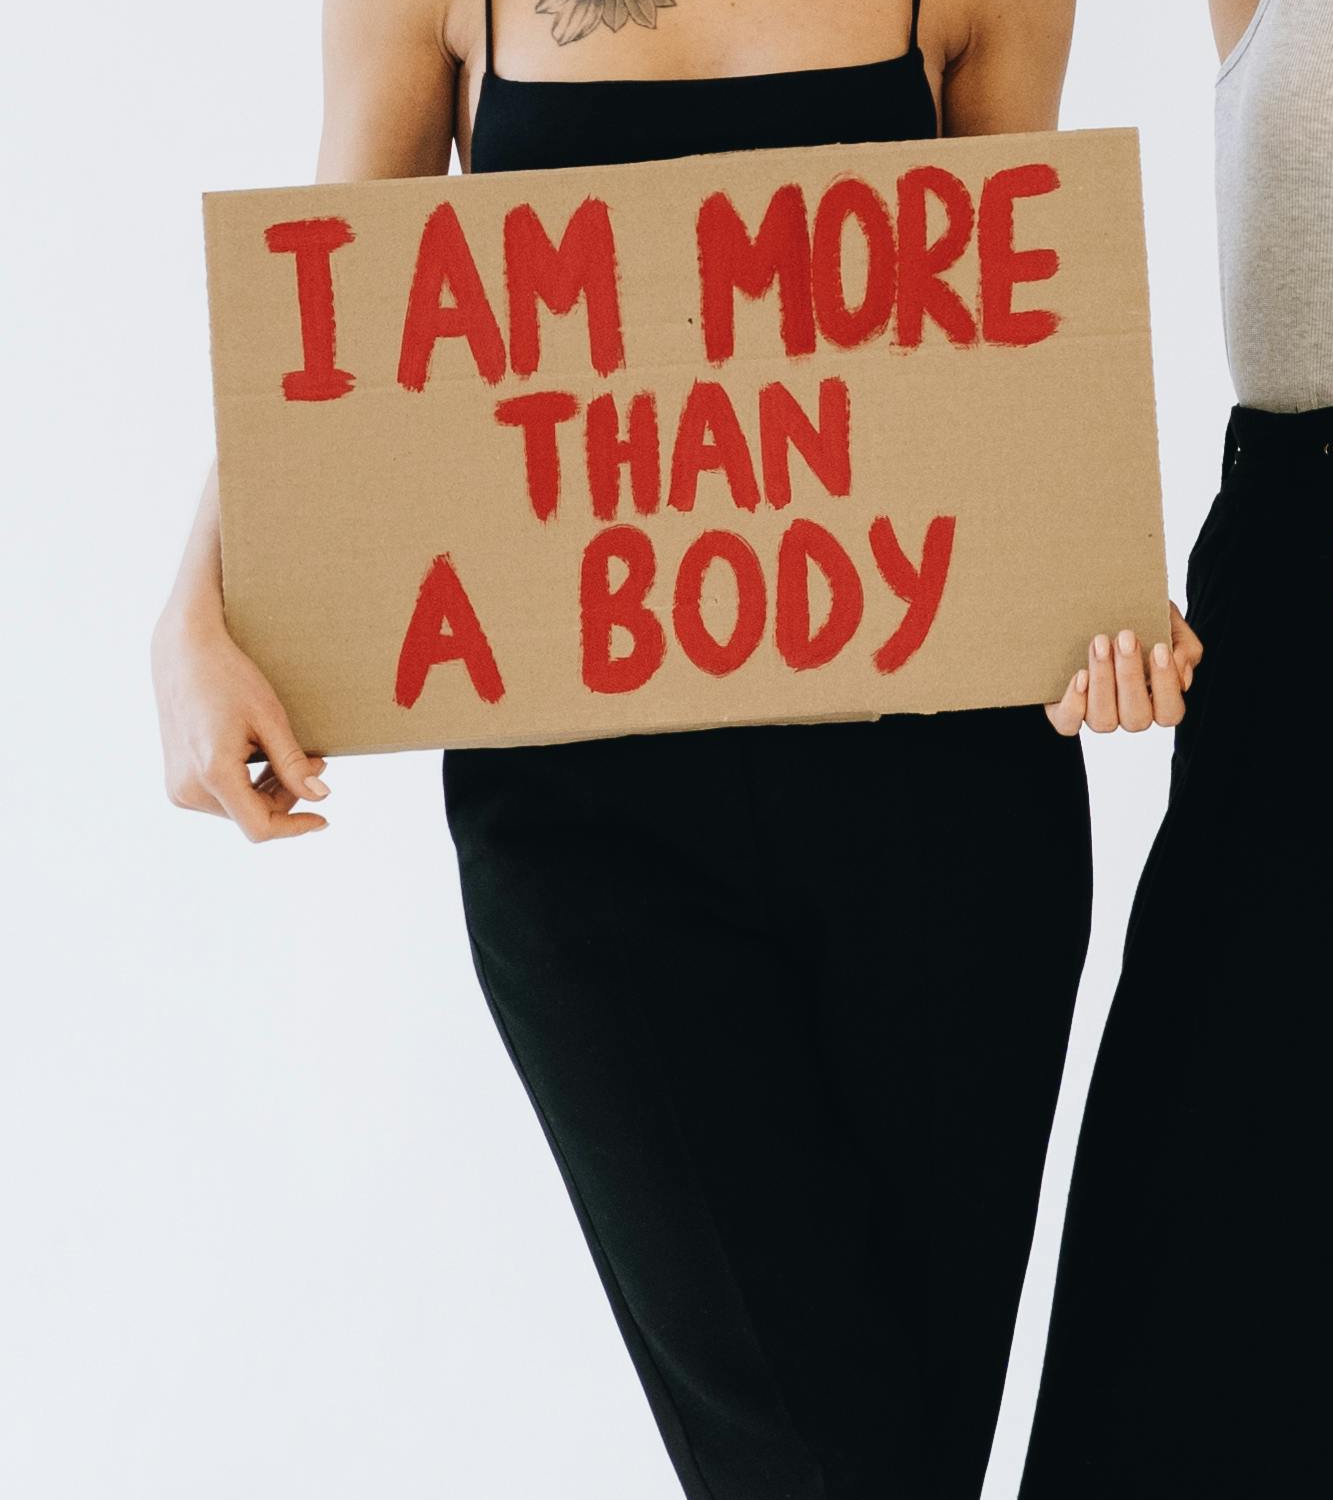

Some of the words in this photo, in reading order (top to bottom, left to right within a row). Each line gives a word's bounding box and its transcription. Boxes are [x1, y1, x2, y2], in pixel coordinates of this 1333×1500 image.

[264, 216, 355, 401] I
[396, 198, 625, 392] AM
[696, 163, 1060, 365] MORE
[494, 377, 852, 521] THAN
[394, 552, 504, 709] A
[579, 516, 955, 694] BODY
